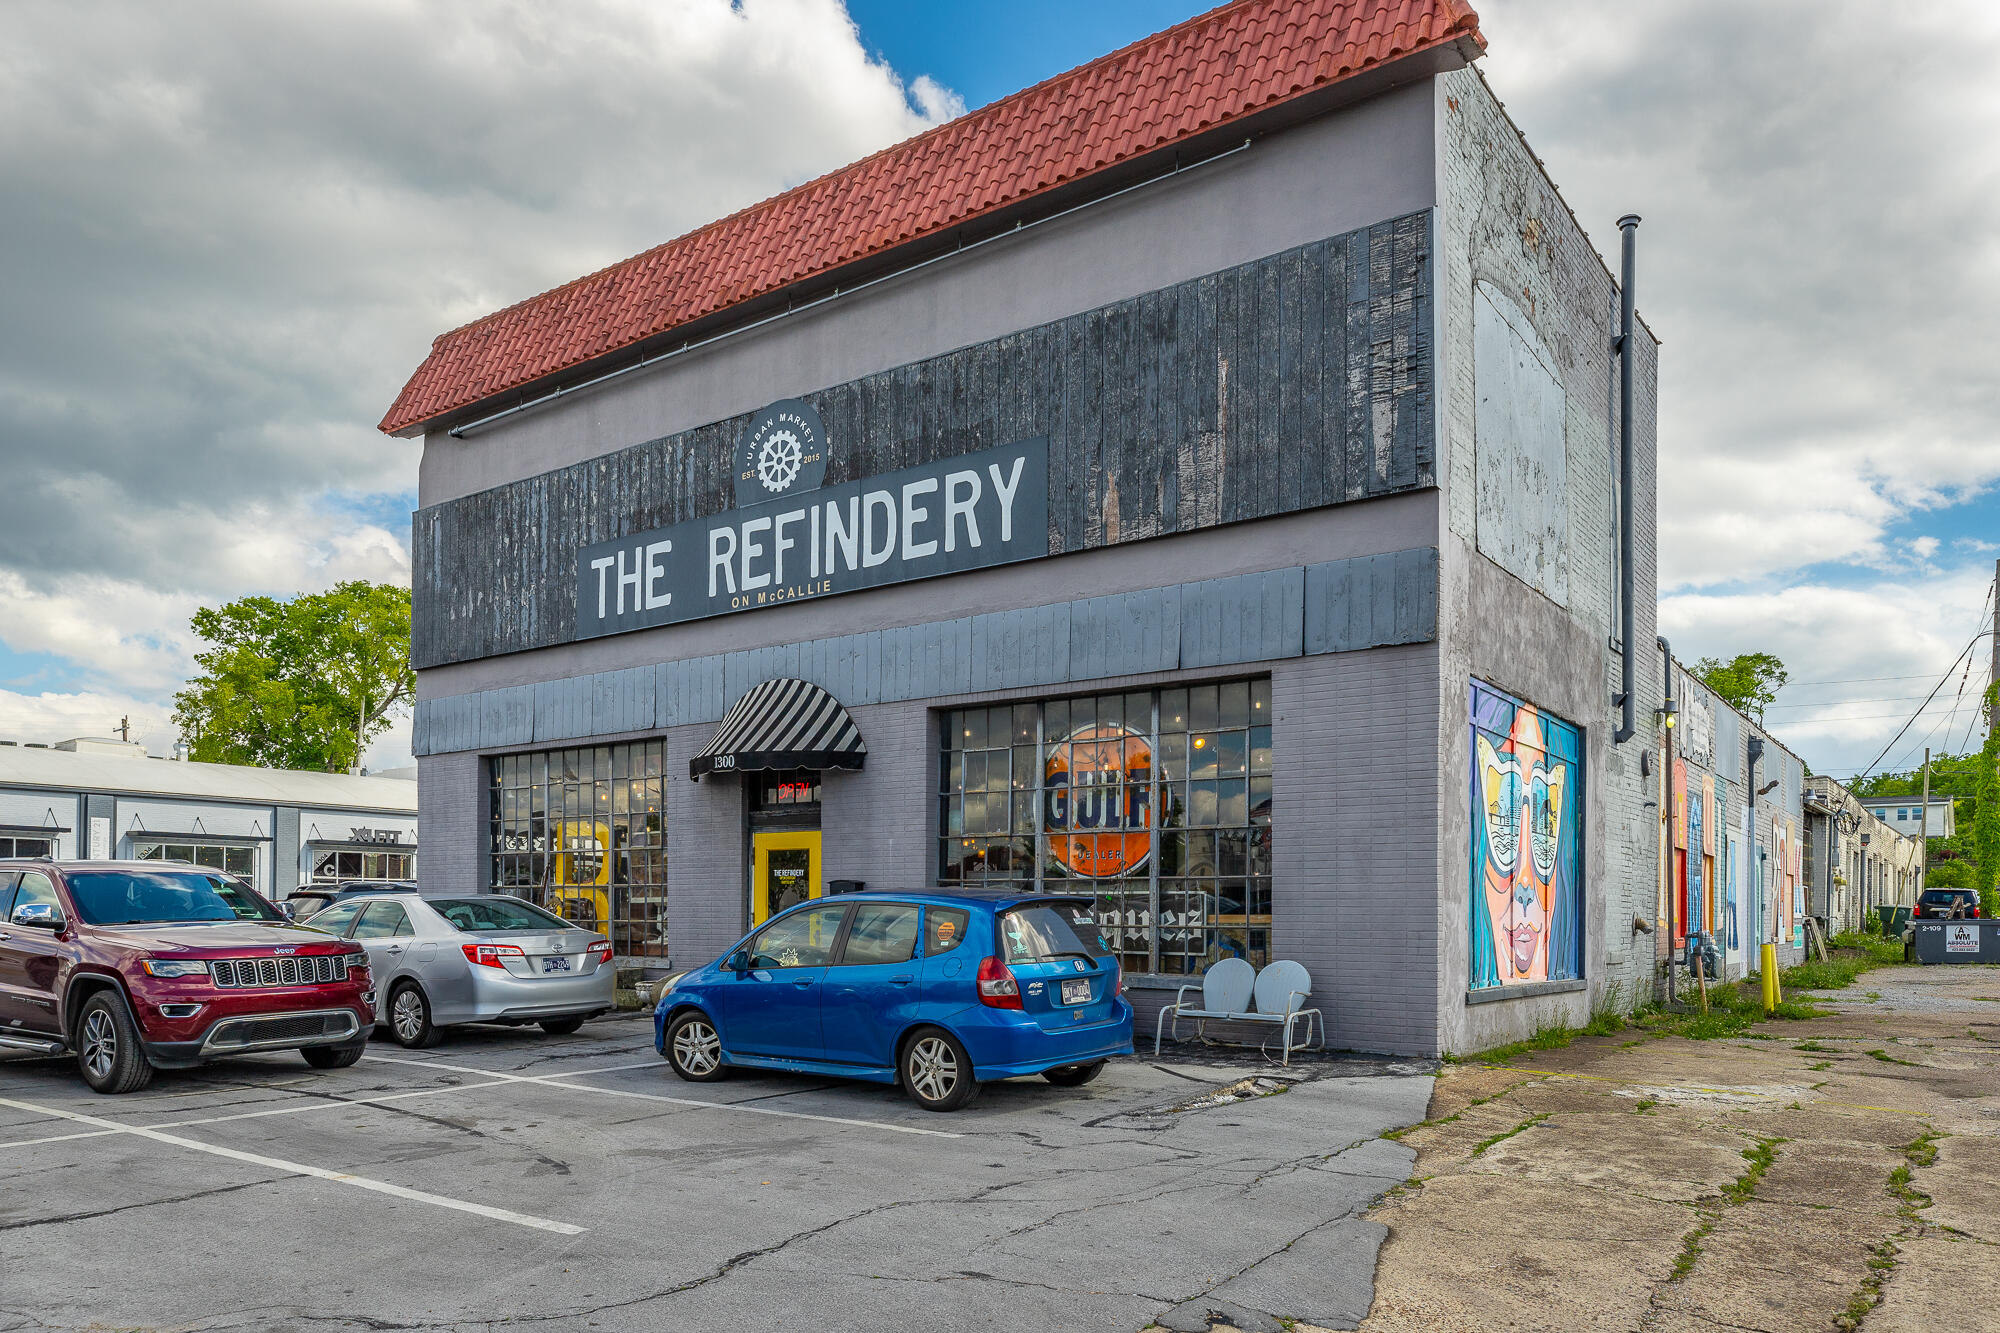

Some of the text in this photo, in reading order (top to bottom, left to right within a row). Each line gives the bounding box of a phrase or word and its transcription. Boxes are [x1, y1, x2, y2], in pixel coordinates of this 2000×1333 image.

[746, 413, 814, 460] URBAN MARKET
[742, 453, 820, 480] EST. 2015
[591, 456, 1025, 619] THE REFINDERY
[731, 580, 831, 609] ON McCALLIE
[714, 754, 735, 768] 1300
[778, 782, 810, 799] OPEN
[1077, 850, 1123, 861] DEALER
[323, 864, 335, 876] C
[1099, 909, 1202, 949] quez
[273, 947, 296, 955] Jeep
